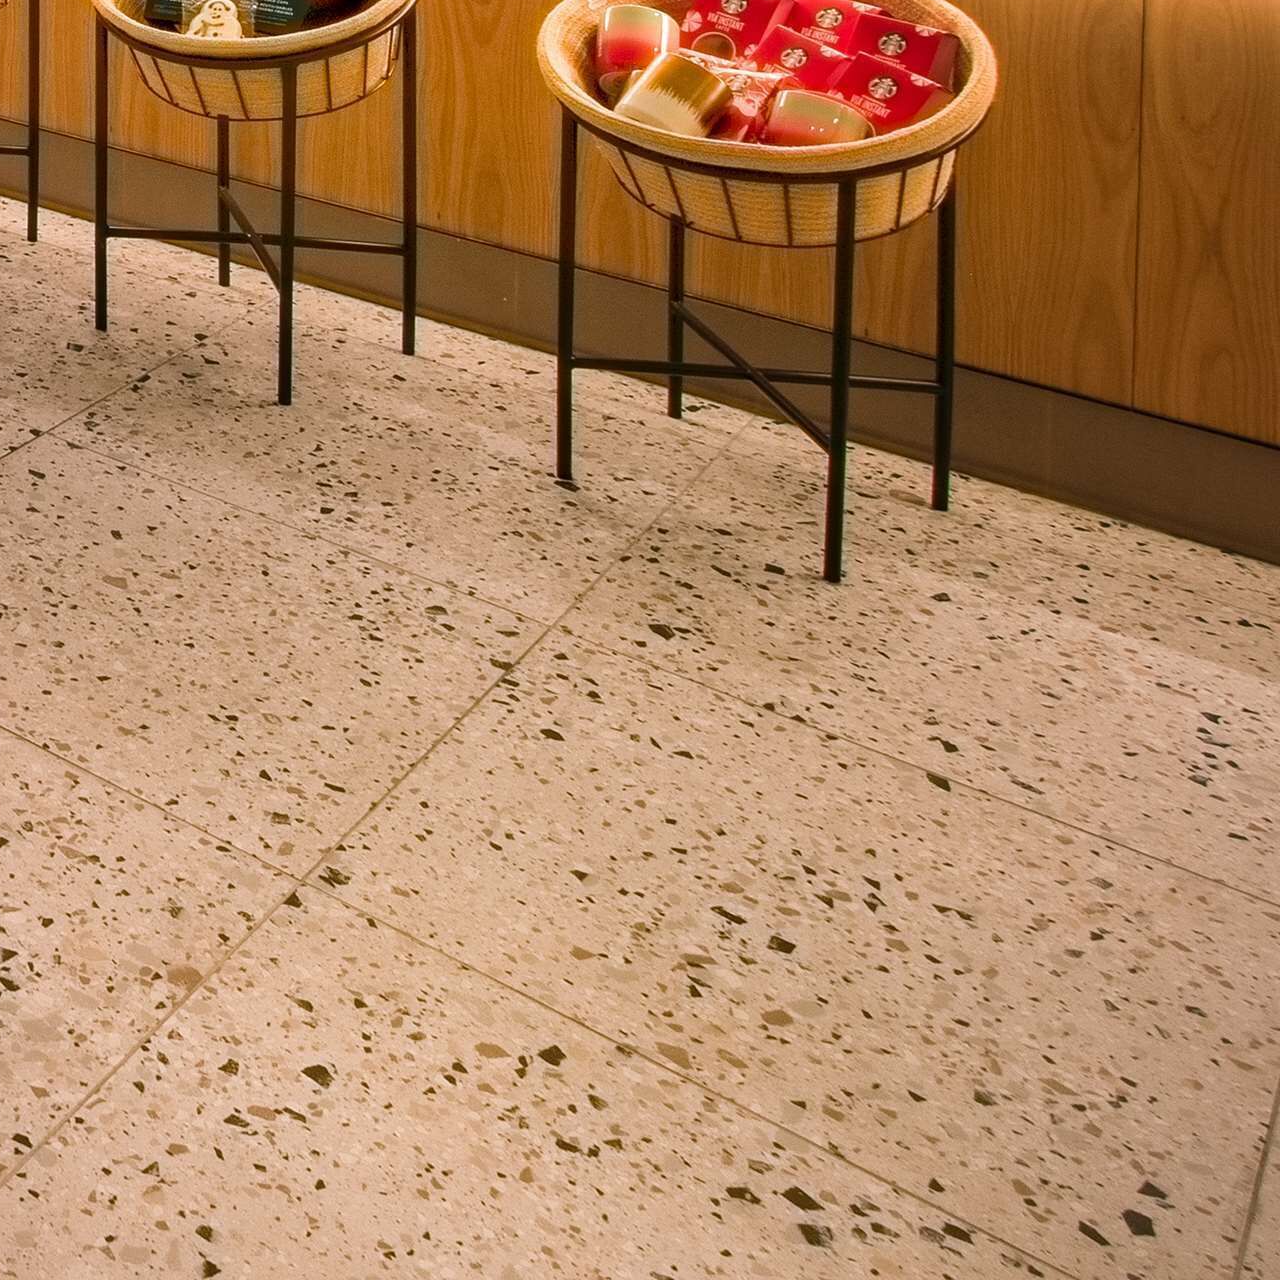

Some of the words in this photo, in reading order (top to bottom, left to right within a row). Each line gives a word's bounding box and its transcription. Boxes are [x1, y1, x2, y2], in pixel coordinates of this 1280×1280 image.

[719, 14, 745, 32] INSTANT
[812, 29, 840, 45] INSTANT
[862, 98, 892, 118] INSTANT
